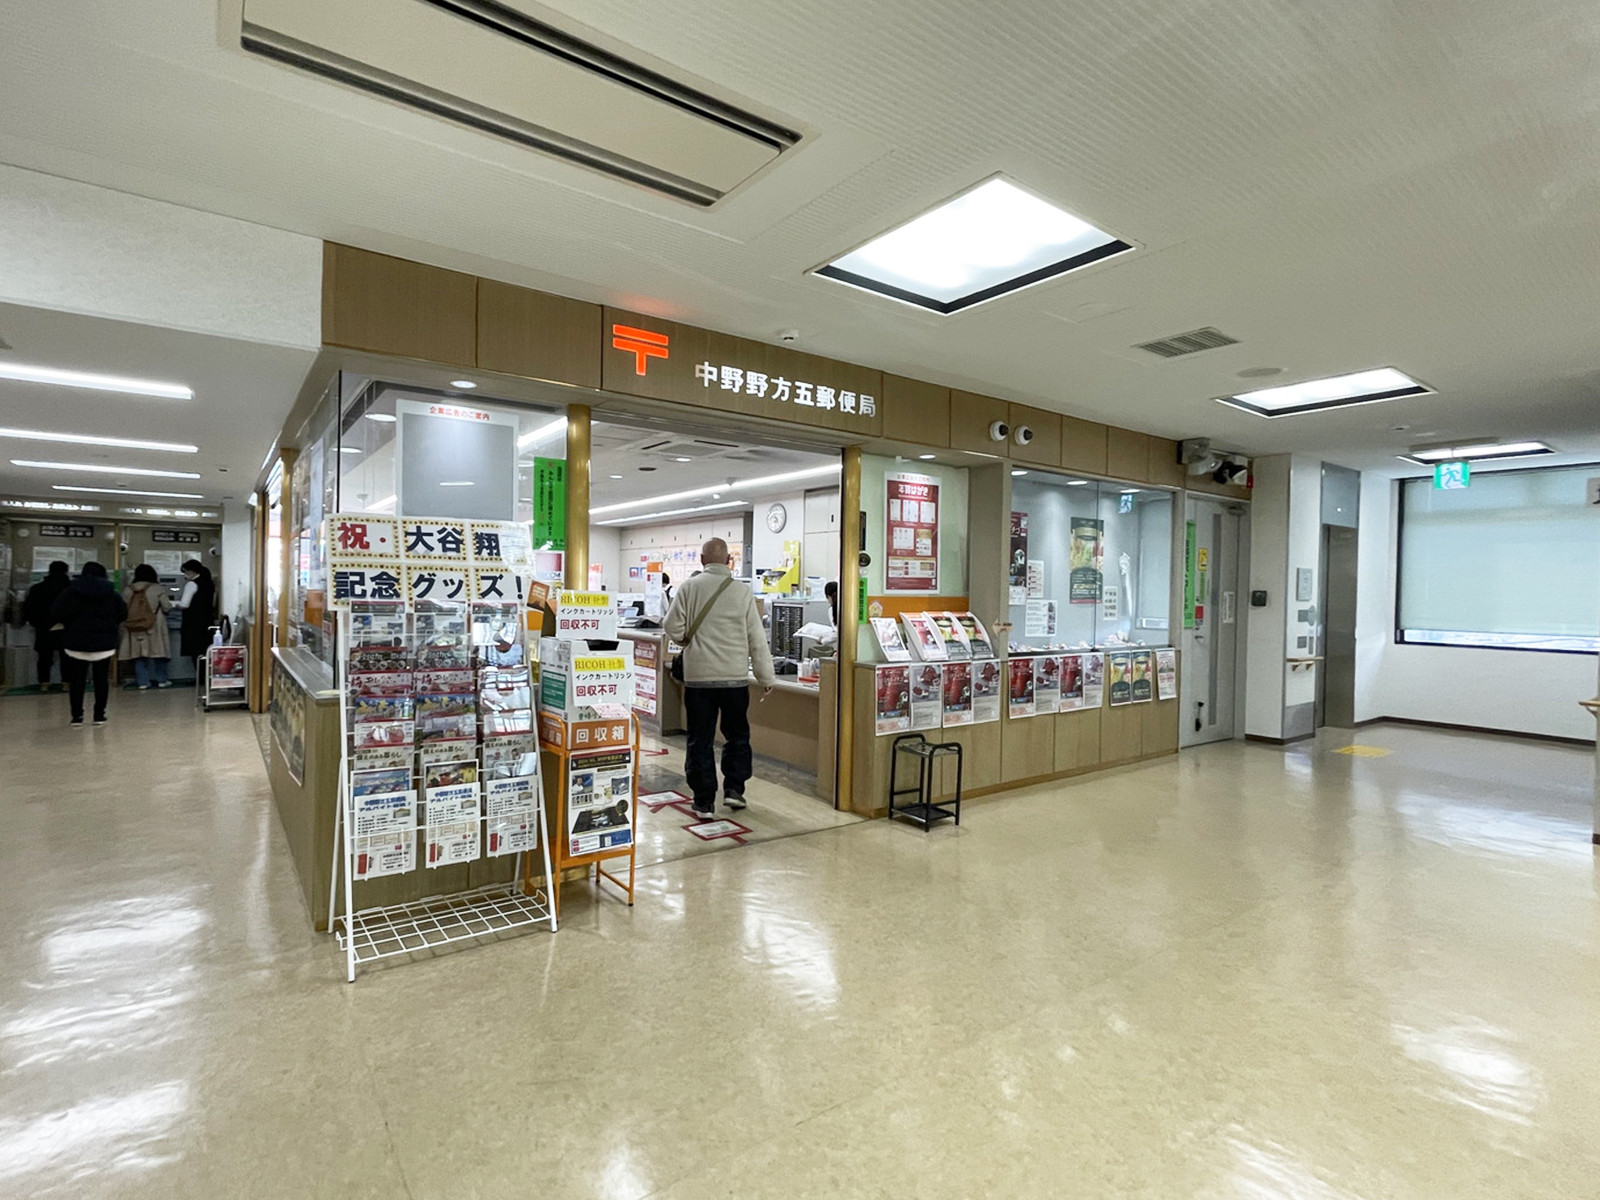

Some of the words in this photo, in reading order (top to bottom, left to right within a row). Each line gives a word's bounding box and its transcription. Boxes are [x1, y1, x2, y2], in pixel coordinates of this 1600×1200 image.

[694, 361, 877, 418] 中野野方五郵便局
[560, 594, 590, 605] RICOH
[560, 608, 614, 616] インクカートリッジ
[560, 619, 600, 630] 回収不可
[575, 660, 606, 670] RICOH
[575, 673, 632, 681] インクカートリッジ
[576, 684, 617, 697] 回収不可
[576, 725, 625, 744] 回収箱
